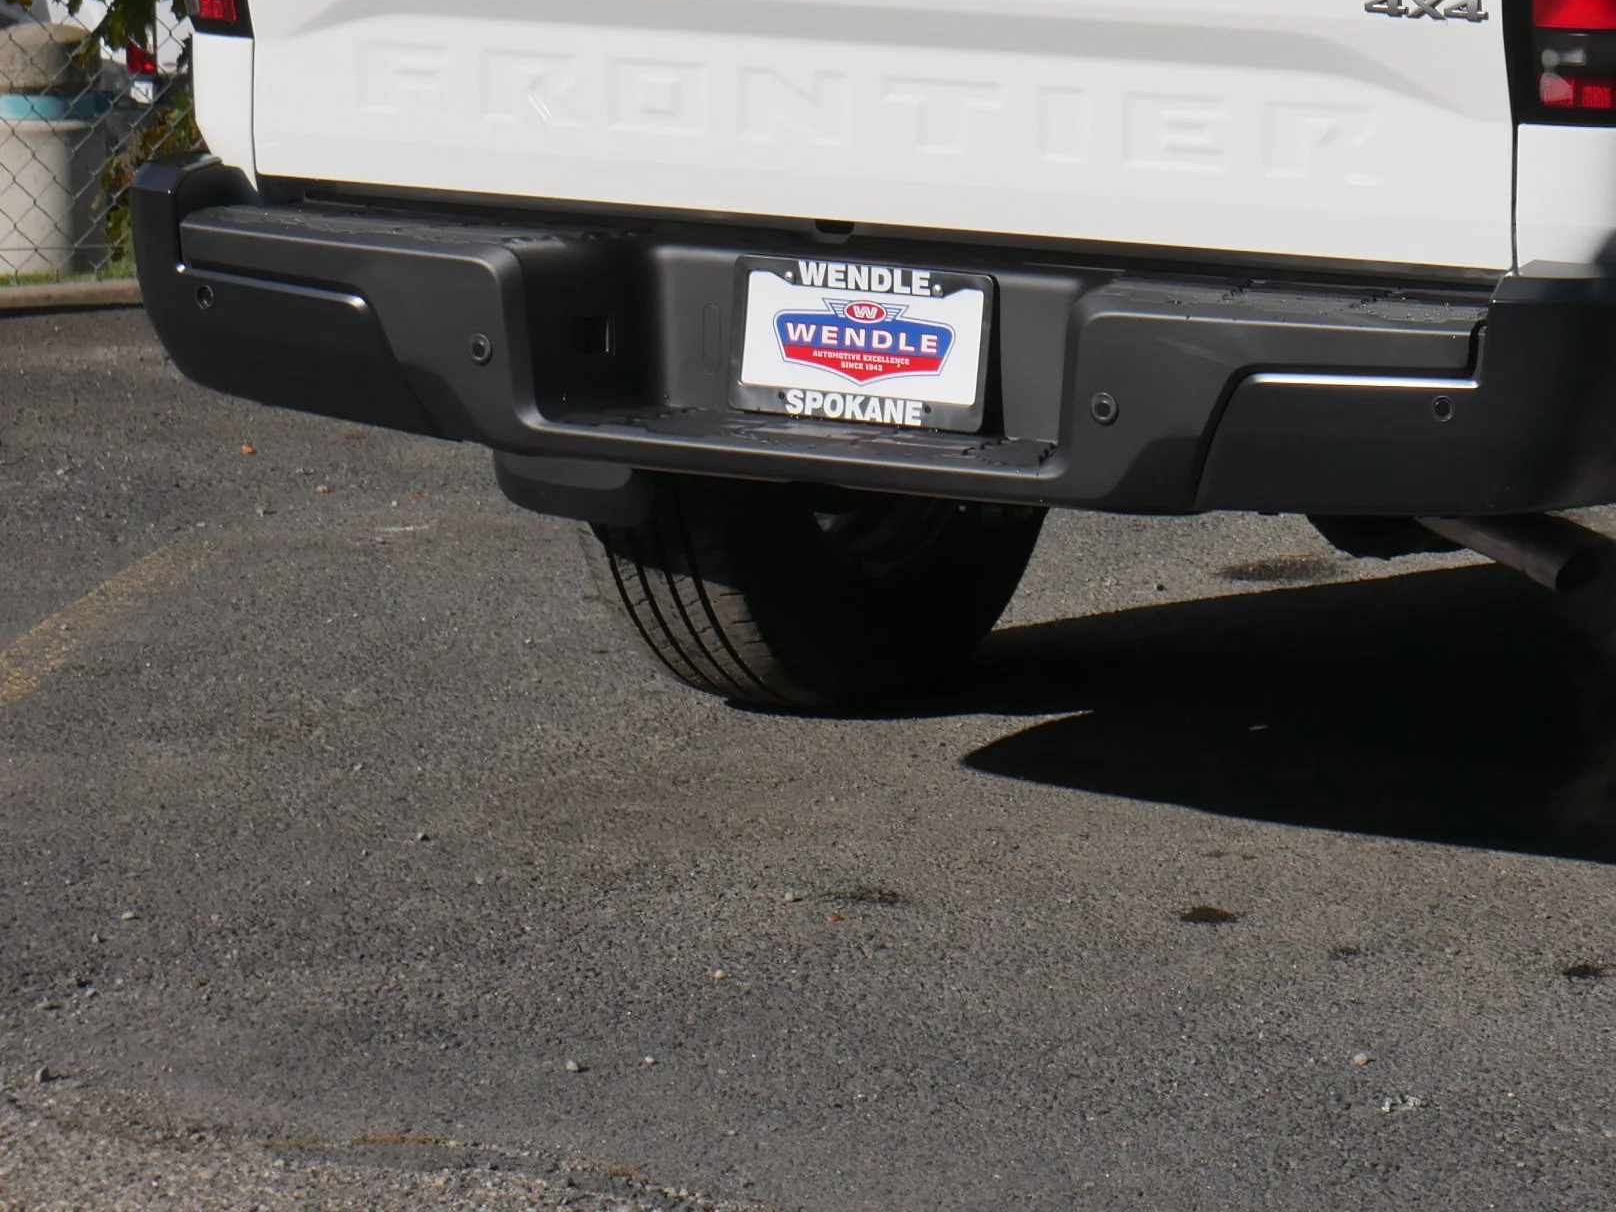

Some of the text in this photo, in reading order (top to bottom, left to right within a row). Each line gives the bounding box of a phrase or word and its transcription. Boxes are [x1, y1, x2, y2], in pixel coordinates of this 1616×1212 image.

[355, 36, 1385, 187] FRONTIER
[798, 260, 931, 297] WENDLE
[786, 322, 938, 354] WENDLE
[812, 350, 910, 366] AUTOMOTIVE EXCELLENCE
[840, 361, 864, 371] SINCE
[785, 388, 923, 426] SPOKANE
